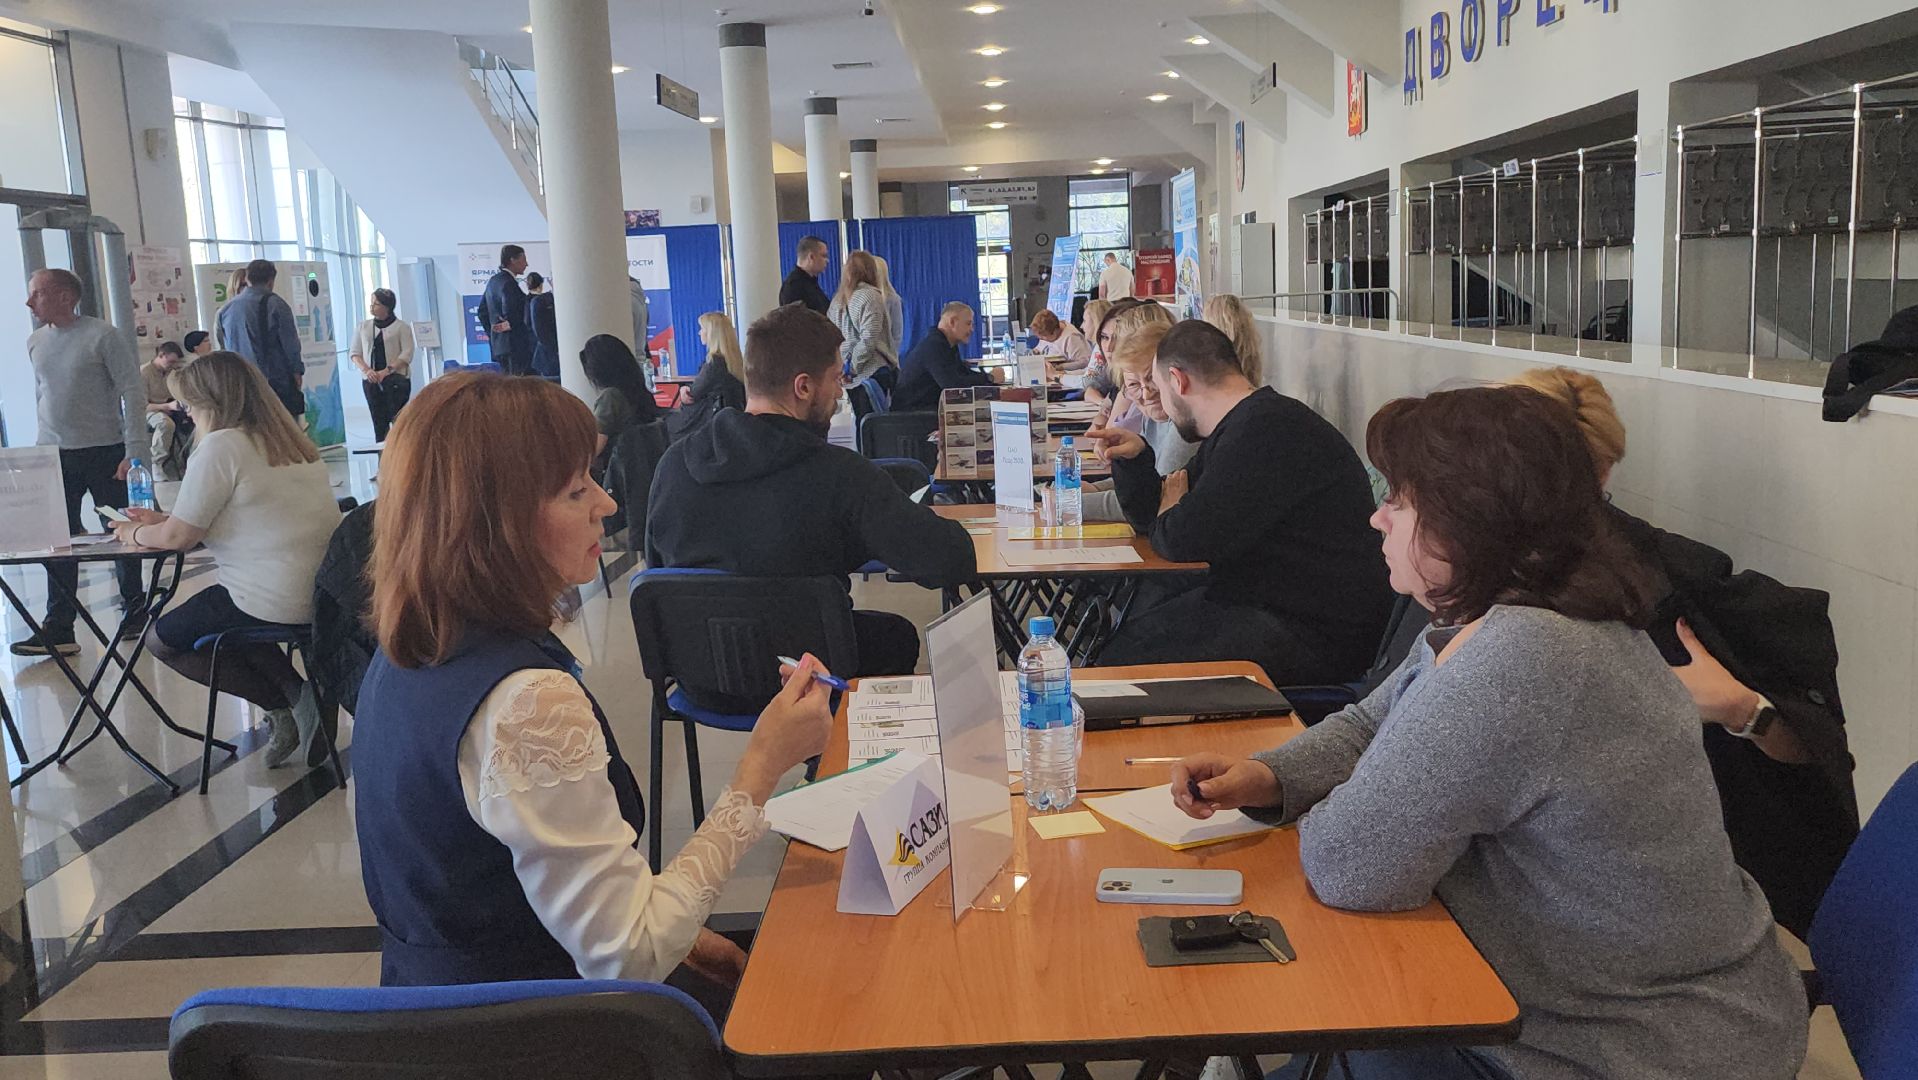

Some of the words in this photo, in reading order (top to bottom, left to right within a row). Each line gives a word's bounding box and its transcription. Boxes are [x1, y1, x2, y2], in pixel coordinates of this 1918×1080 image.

[1403, 0, 1619, 102] ДВОР
[627, 259, 654, 267] ТОСТИ
[909, 802, 948, 848] САЗИ
[903, 860, 925, 884] ГРУППА
